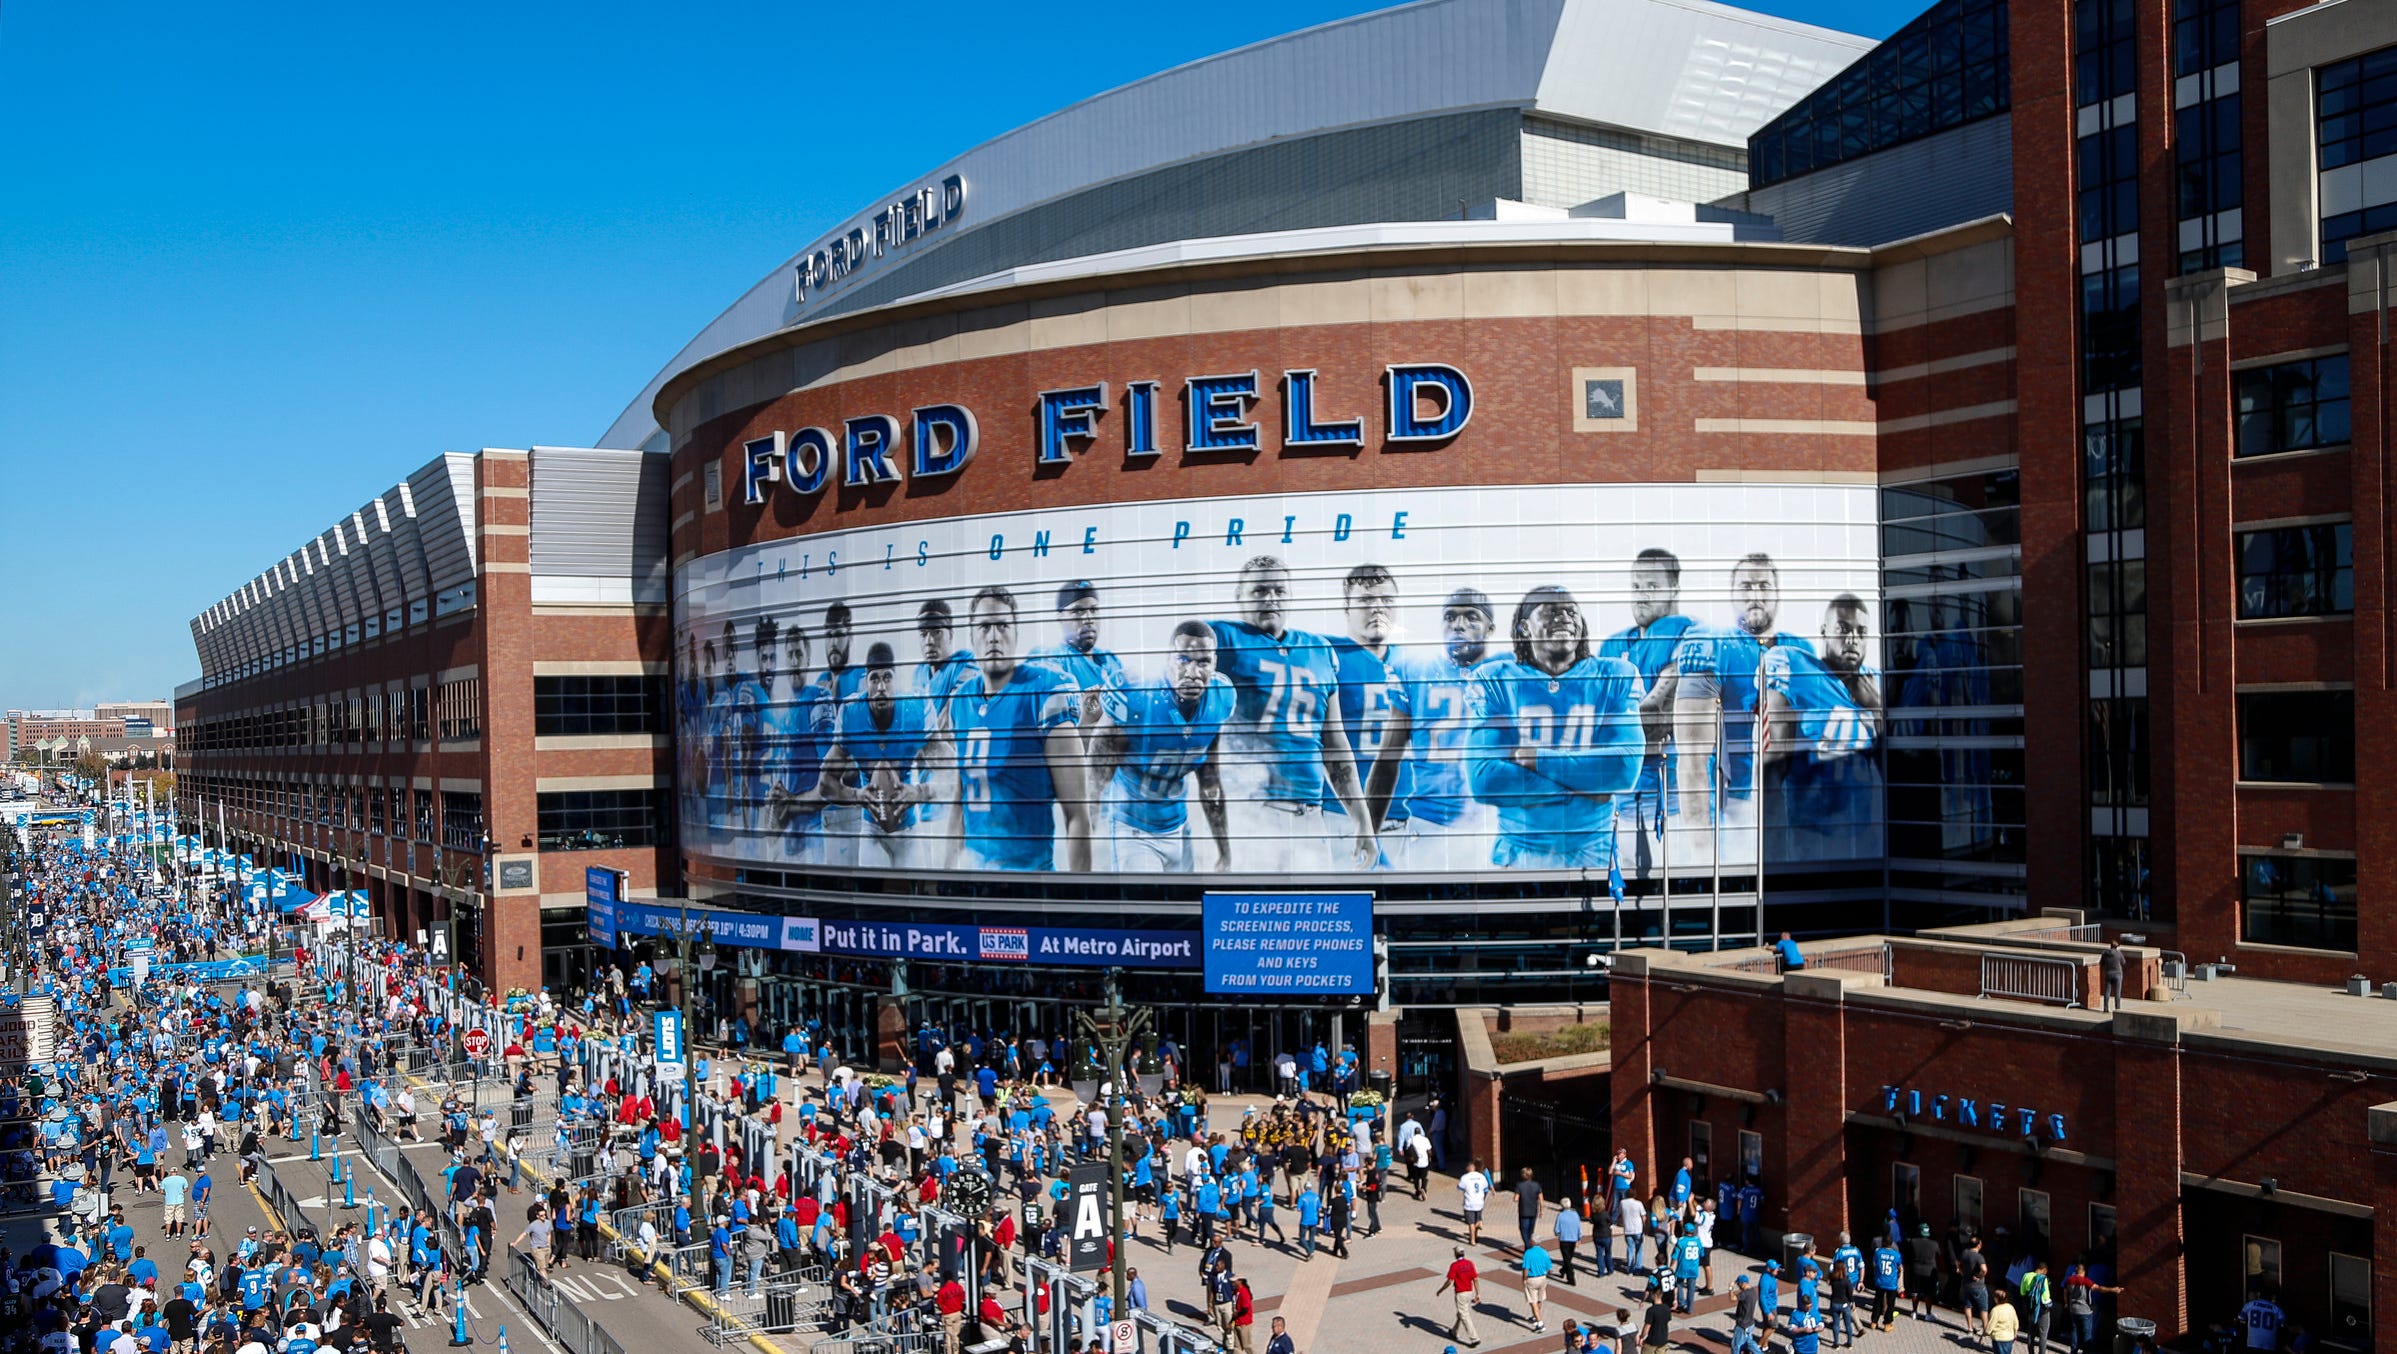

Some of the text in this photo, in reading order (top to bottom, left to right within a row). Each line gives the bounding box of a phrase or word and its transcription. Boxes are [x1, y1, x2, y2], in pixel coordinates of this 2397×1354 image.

[796, 174, 968, 303] FORD FIELD
[740, 363, 1474, 505] FORD FIELD
[756, 512, 1408, 583] THIS IS ONE PRIDE
[1257, 658, 1319, 739] 76
[964, 727, 992, 812] 9
[1235, 902, 1340, 914] TO EXPEDITE THE
[738, 924, 769, 939] 4:30PM
[787, 925, 813, 942] HOME
[1220, 920, 1354, 933] SCREENING PROCESS,
[432, 935, 448, 955] A
[824, 925, 968, 955] Put it in Park.
[981, 935, 1026, 950] US PARK
[1040, 936, 1190, 959] At Metro Airport
[1212, 938, 1364, 951] PLEASE REMOVE PHONES
[1257, 956, 1318, 969] AND KEYS
[1221, 974, 1353, 987] FROM YOUR POCKETS
[466, 1036, 488, 1047] STOP
[661, 1016, 677, 1060] LIONS
[208, 1044, 216, 1055] 15
[1882, 1085, 2066, 1141] TICKETS
[1078, 1182, 1099, 1194] GATE
[1074, 1194, 1104, 1240] A
[1685, 1246, 1699, 1260] 68
[1847, 1257, 1856, 1274] 9
[1881, 1260, 1893, 1276] 15
[249, 1281, 258, 1295] 9
[550, 1271, 639, 1303] NLY
[2249, 1309, 2276, 1331] 80
